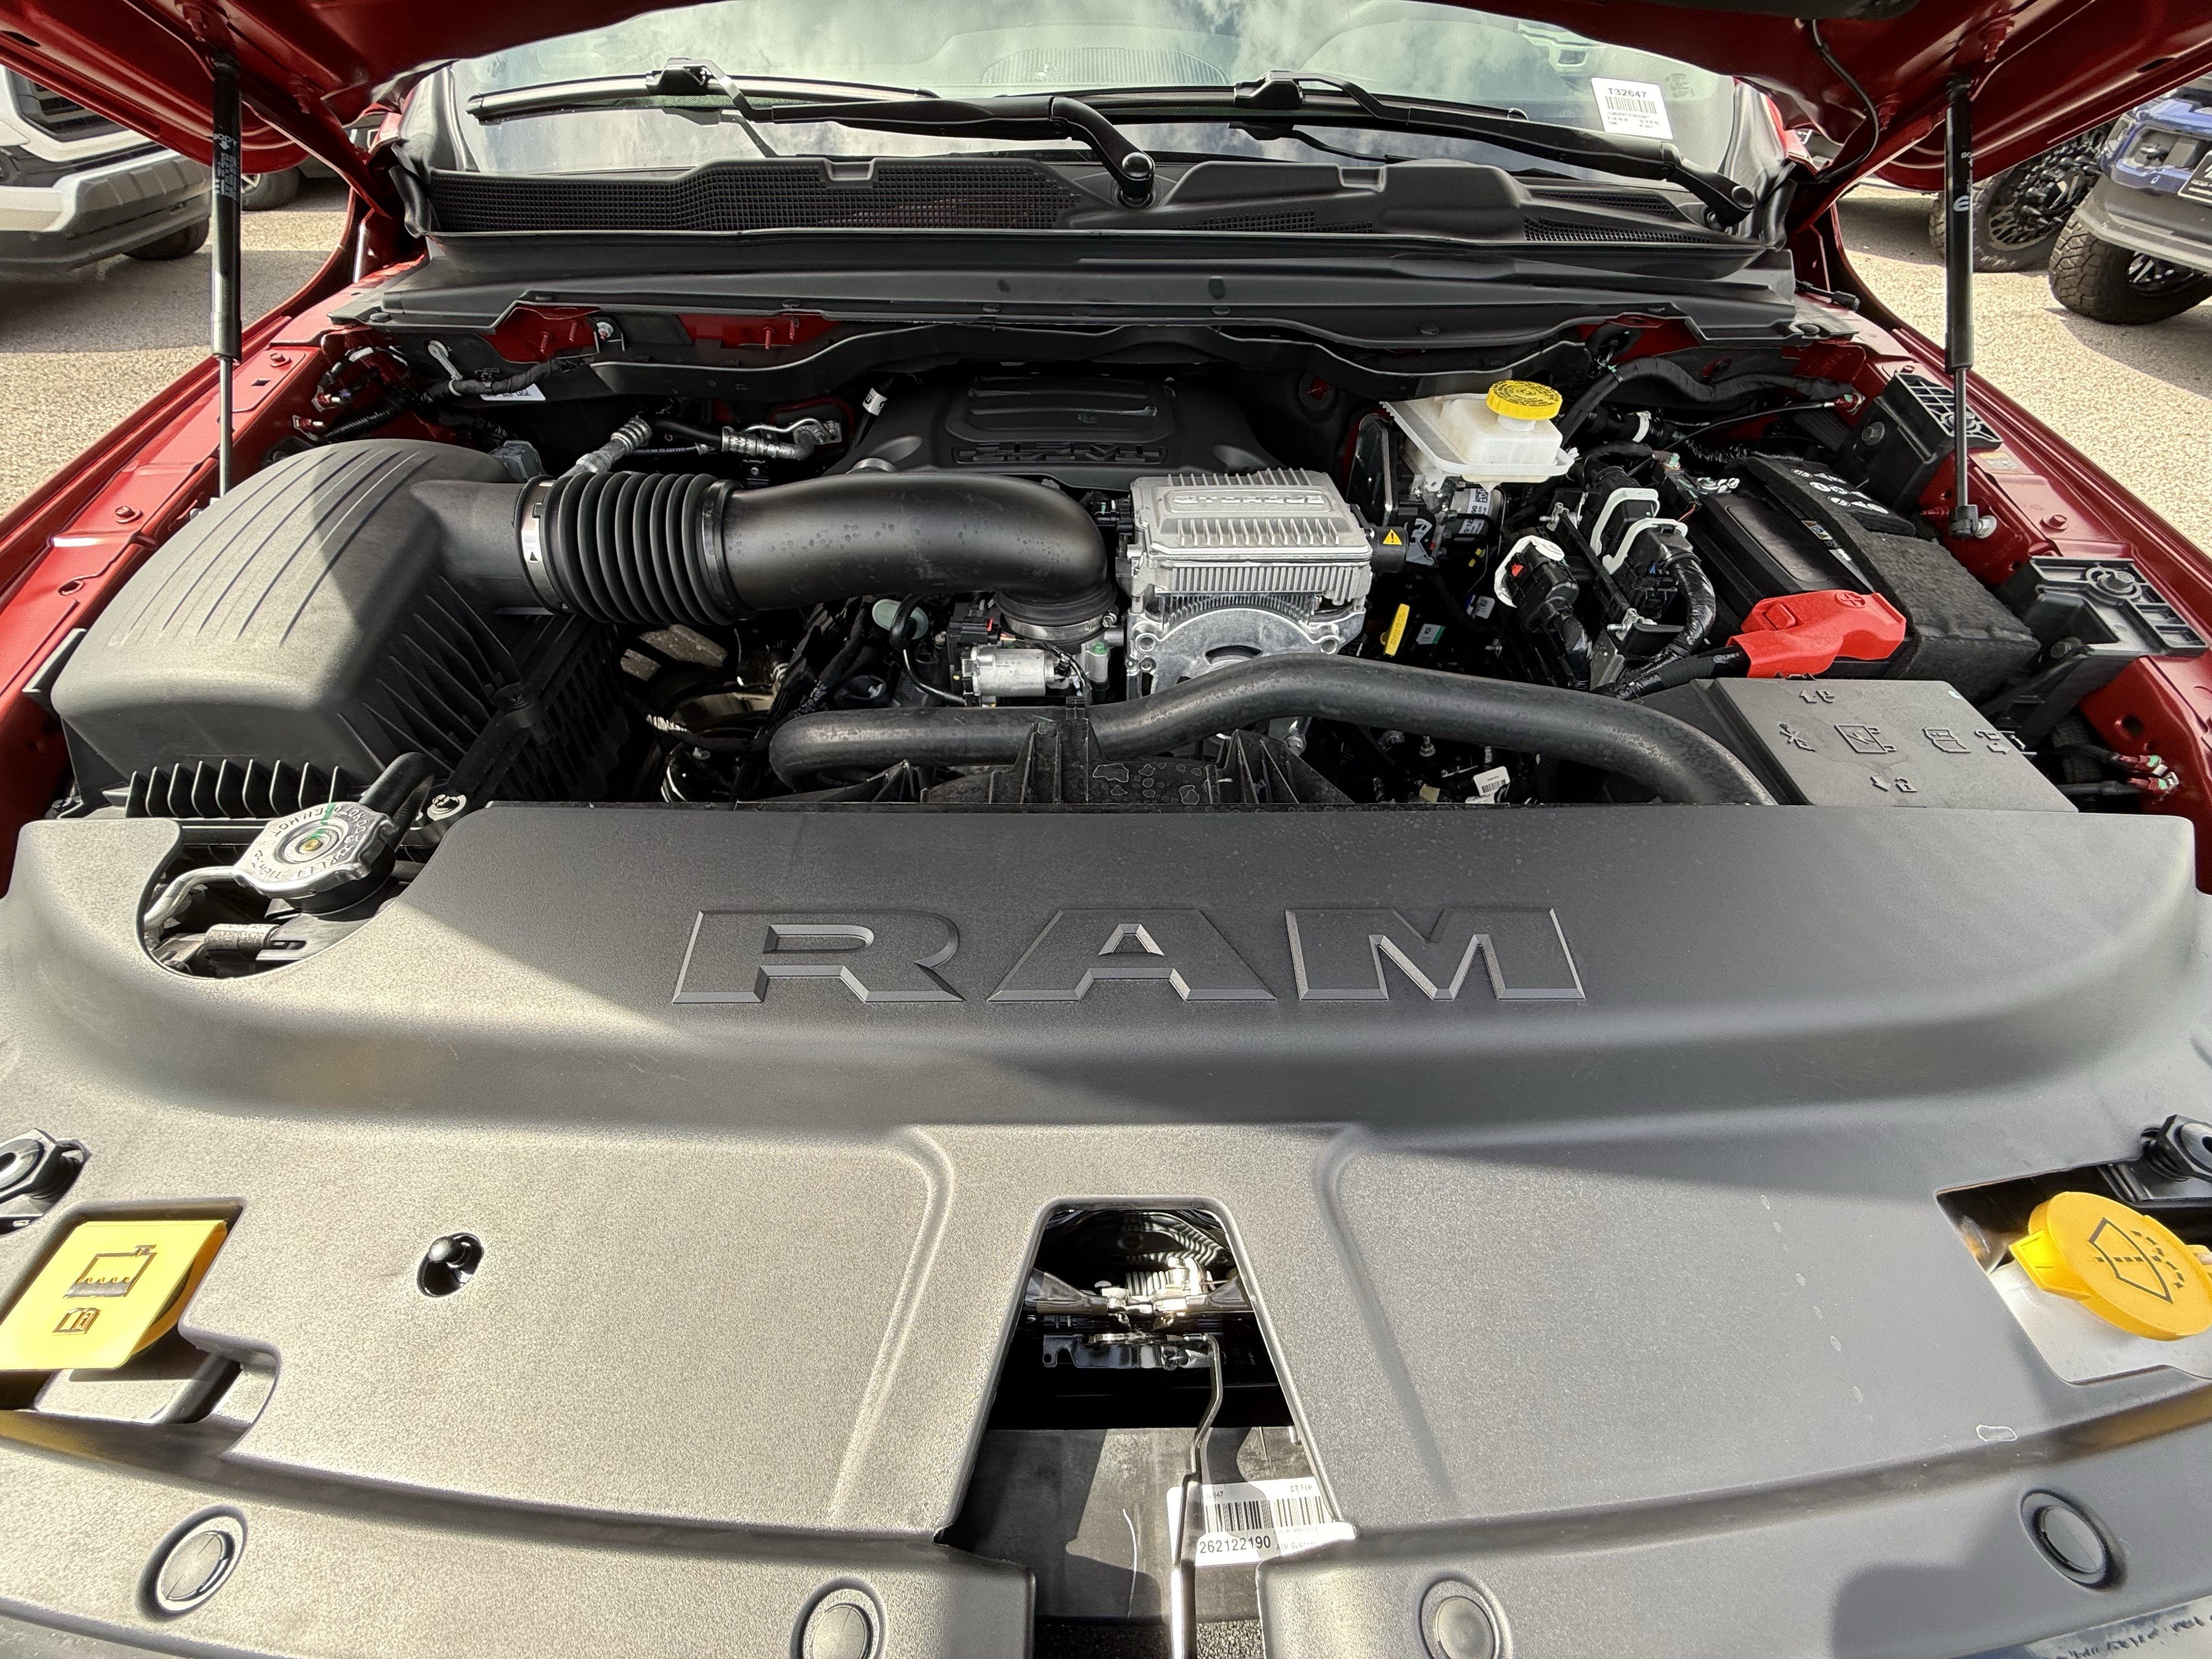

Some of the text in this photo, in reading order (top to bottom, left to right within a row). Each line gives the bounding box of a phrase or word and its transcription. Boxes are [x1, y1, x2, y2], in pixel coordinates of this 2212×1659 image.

[1607, 88, 1647, 98] T32647
[672, 908, 1587, 1003] RAM
[1199, 1535, 1271, 1554] 262122190
